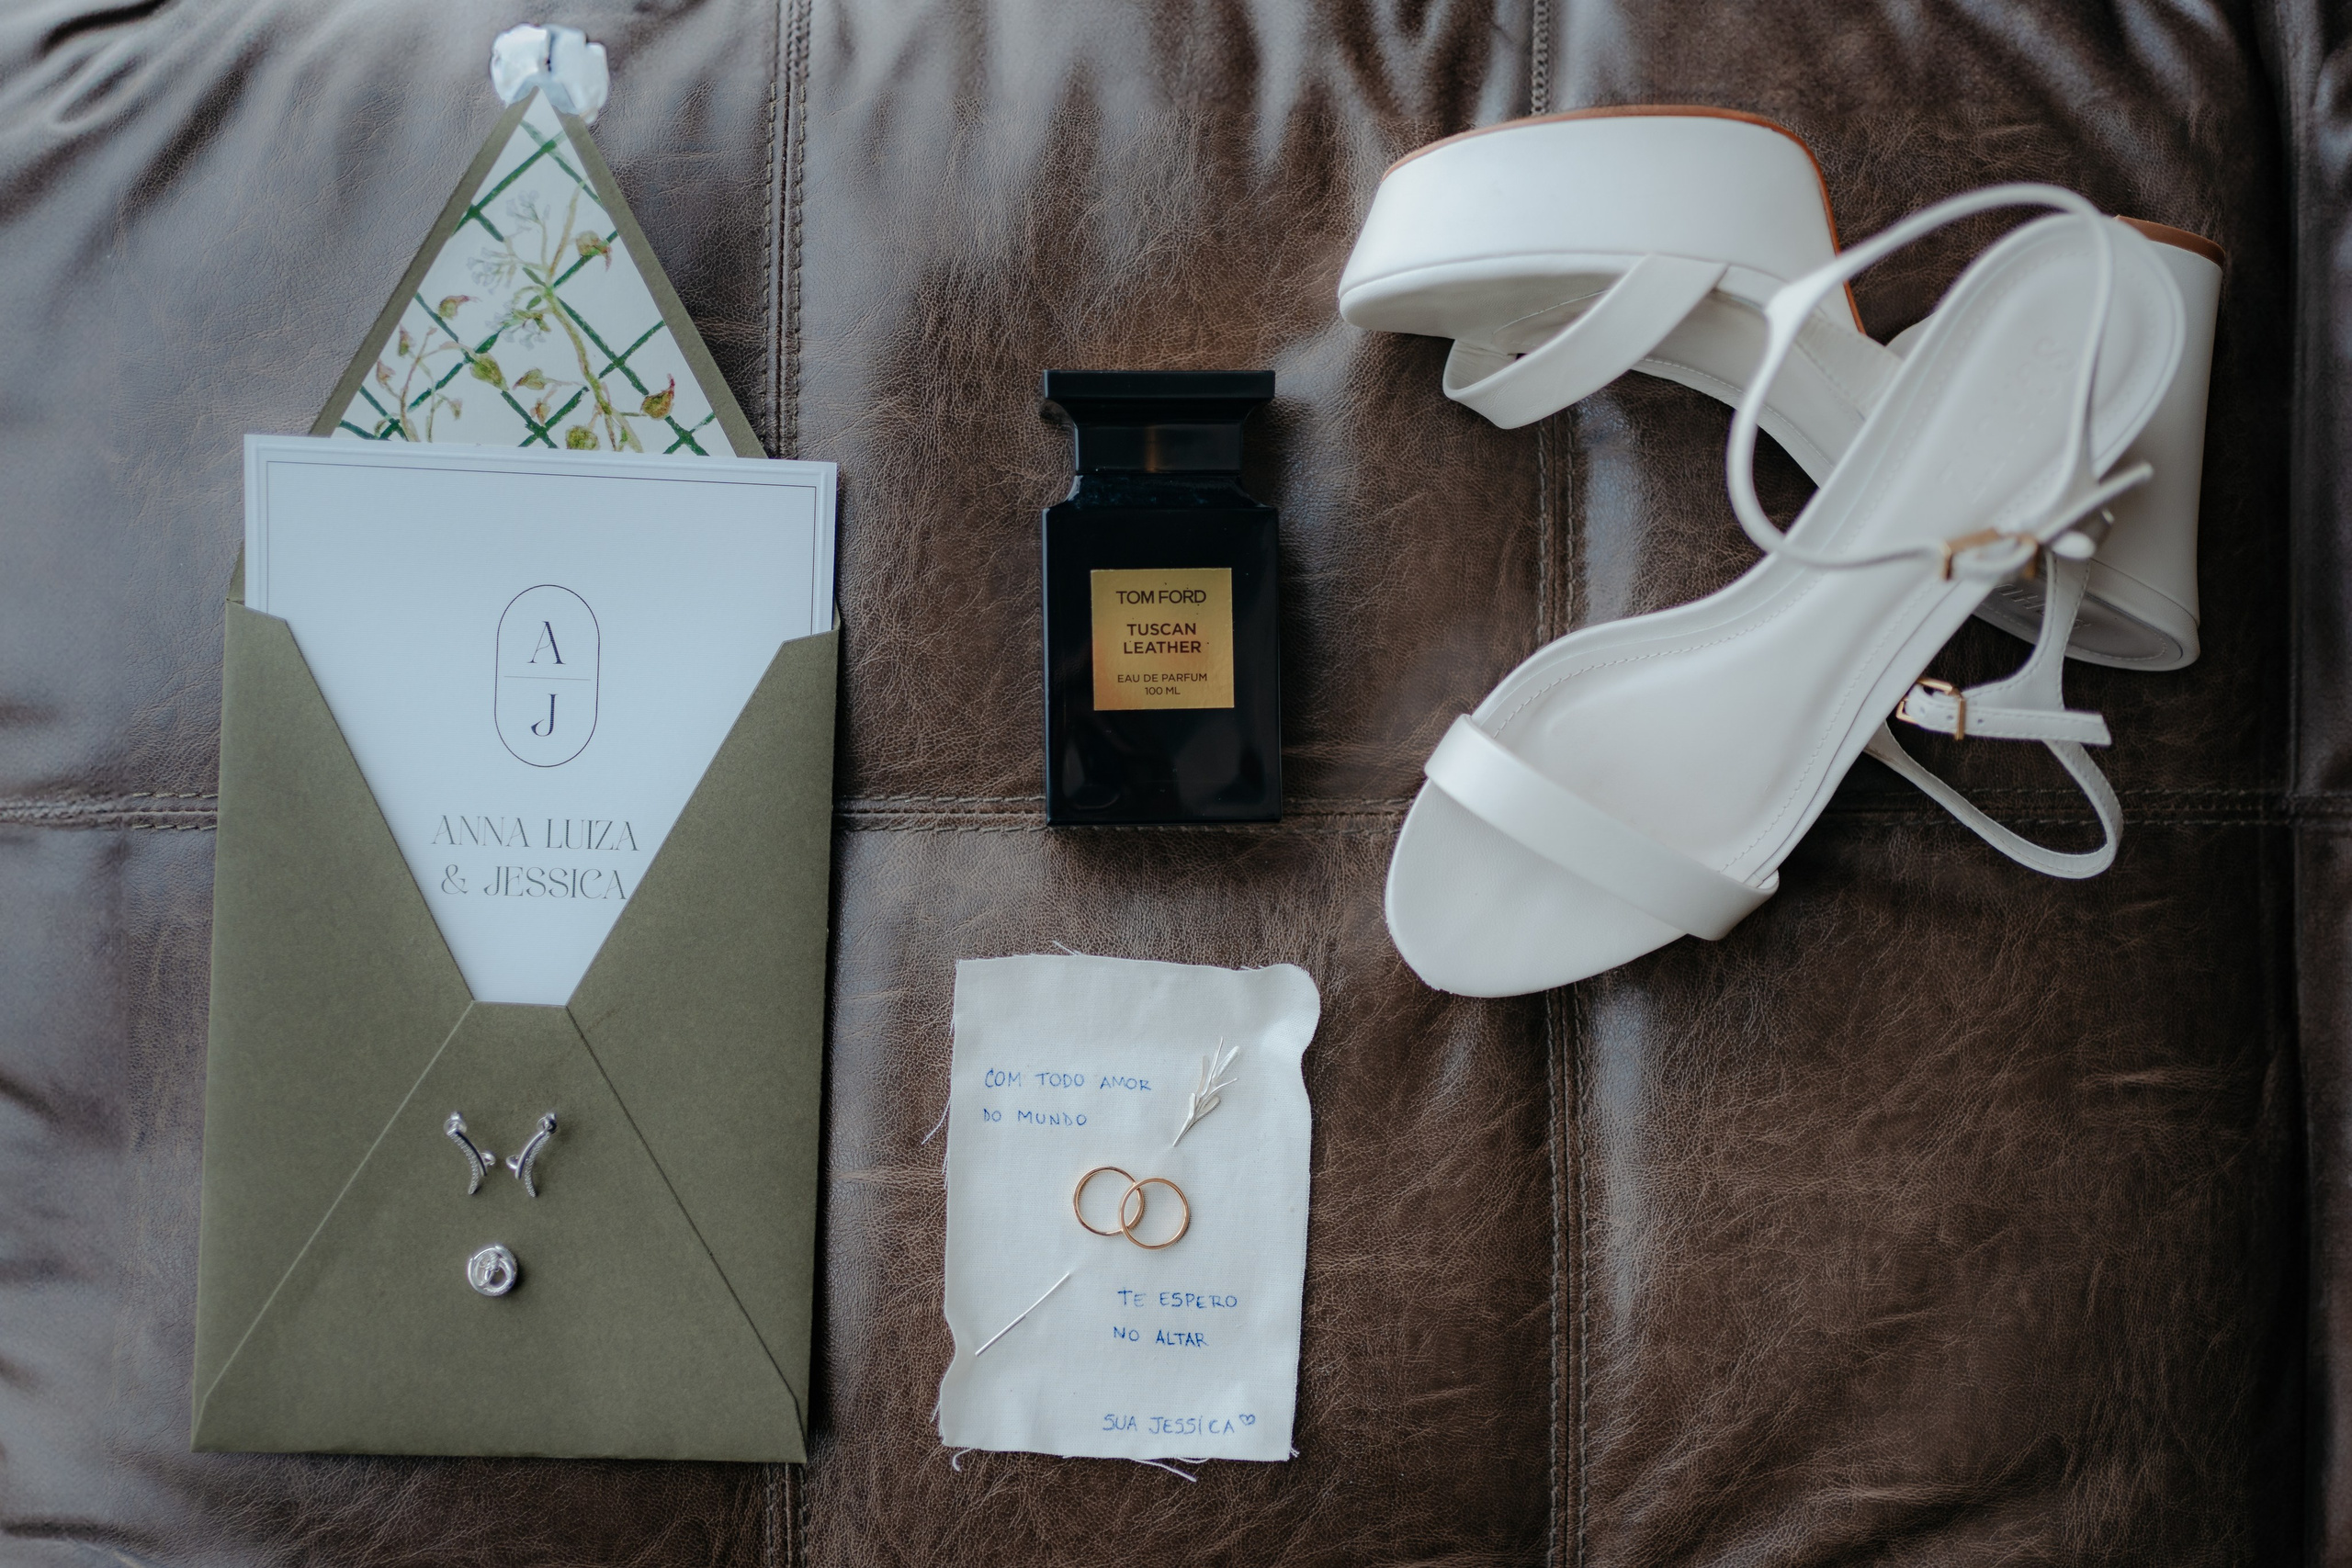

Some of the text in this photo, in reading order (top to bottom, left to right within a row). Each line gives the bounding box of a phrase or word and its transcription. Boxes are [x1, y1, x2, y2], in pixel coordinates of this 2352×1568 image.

[1115, 590, 1206, 604] TOM FORD
[1126, 623, 1196, 636] TUSCAN
[526, 620, 567, 665] A
[1124, 640, 1202, 654] LEATHER
[1117, 673, 1207, 682] EAU DE PARFUM
[1145, 686, 1181, 695] 100 ML
[530, 694, 559, 737] J
[431, 814, 640, 852] ANNA LUIZA
[441, 863, 628, 900] & JESSICA
[984, 1068, 1152, 1091] COM TODO AMOR
[983, 1108, 1088, 1126] DO MUNDO
[1117, 1289, 1238, 1309] TE ESPERO
[1113, 1325, 1209, 1348] NO ALTAR
[1102, 1414, 1138, 1431] SUA
